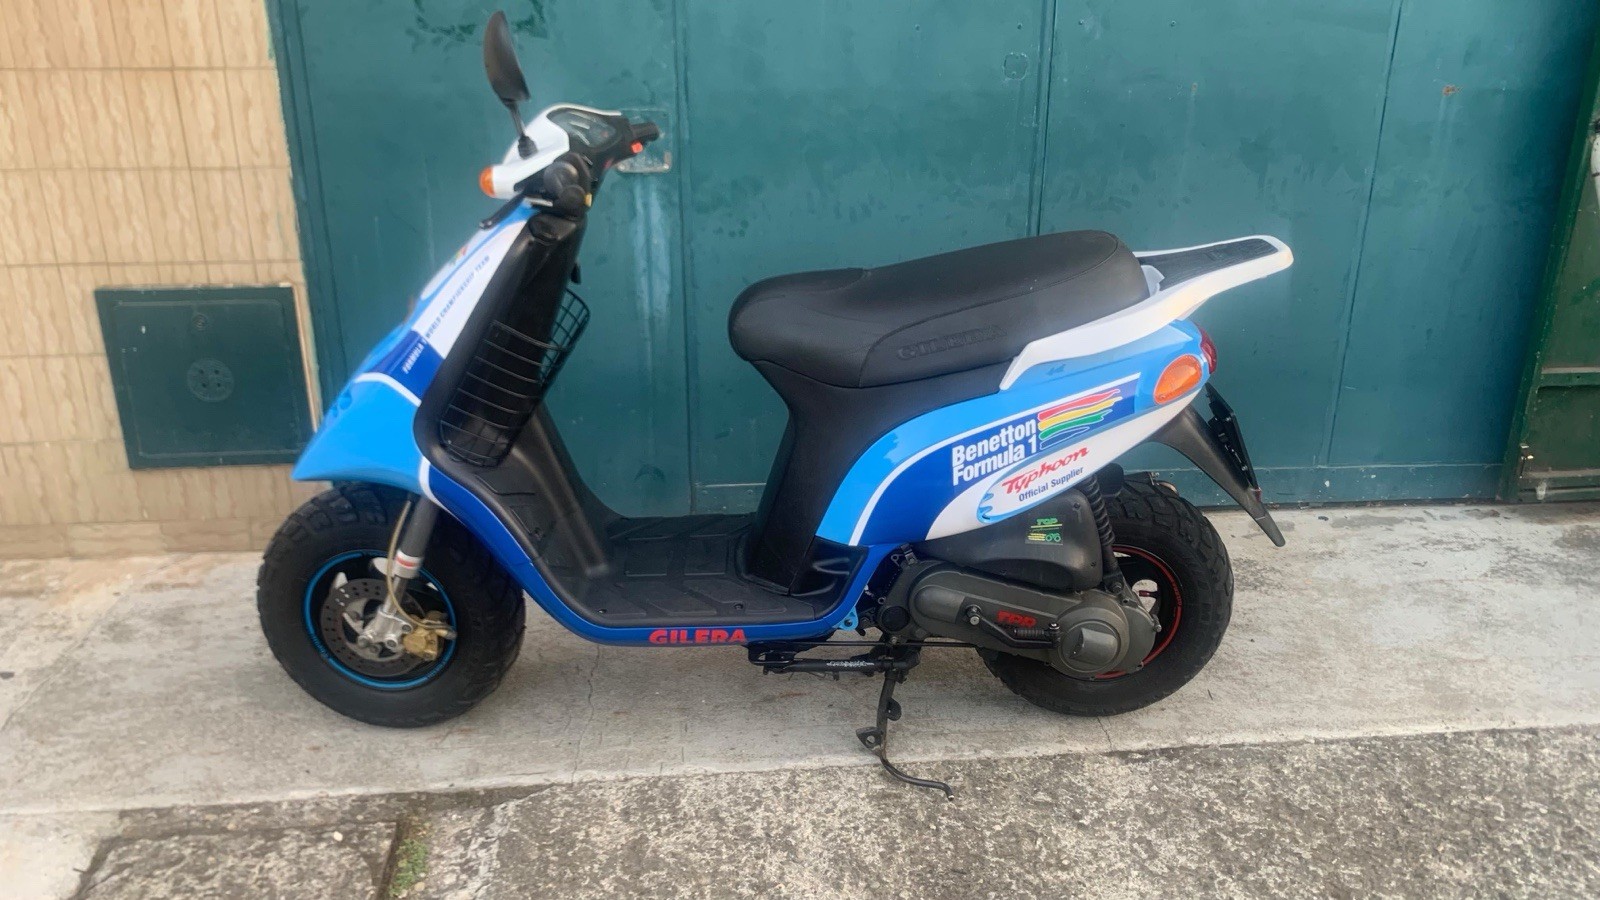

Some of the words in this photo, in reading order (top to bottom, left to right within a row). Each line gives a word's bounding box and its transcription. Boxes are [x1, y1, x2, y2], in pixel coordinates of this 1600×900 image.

[952, 419, 1037, 467] Benetton
[952, 443, 1025, 486] Formula
[1027, 434, 1037, 456] 1
[1001, 446, 1089, 494] Typhoon
[1018, 483, 1049, 502] Official
[1051, 466, 1084, 488] Supplier
[648, 628, 748, 645] GILERA
